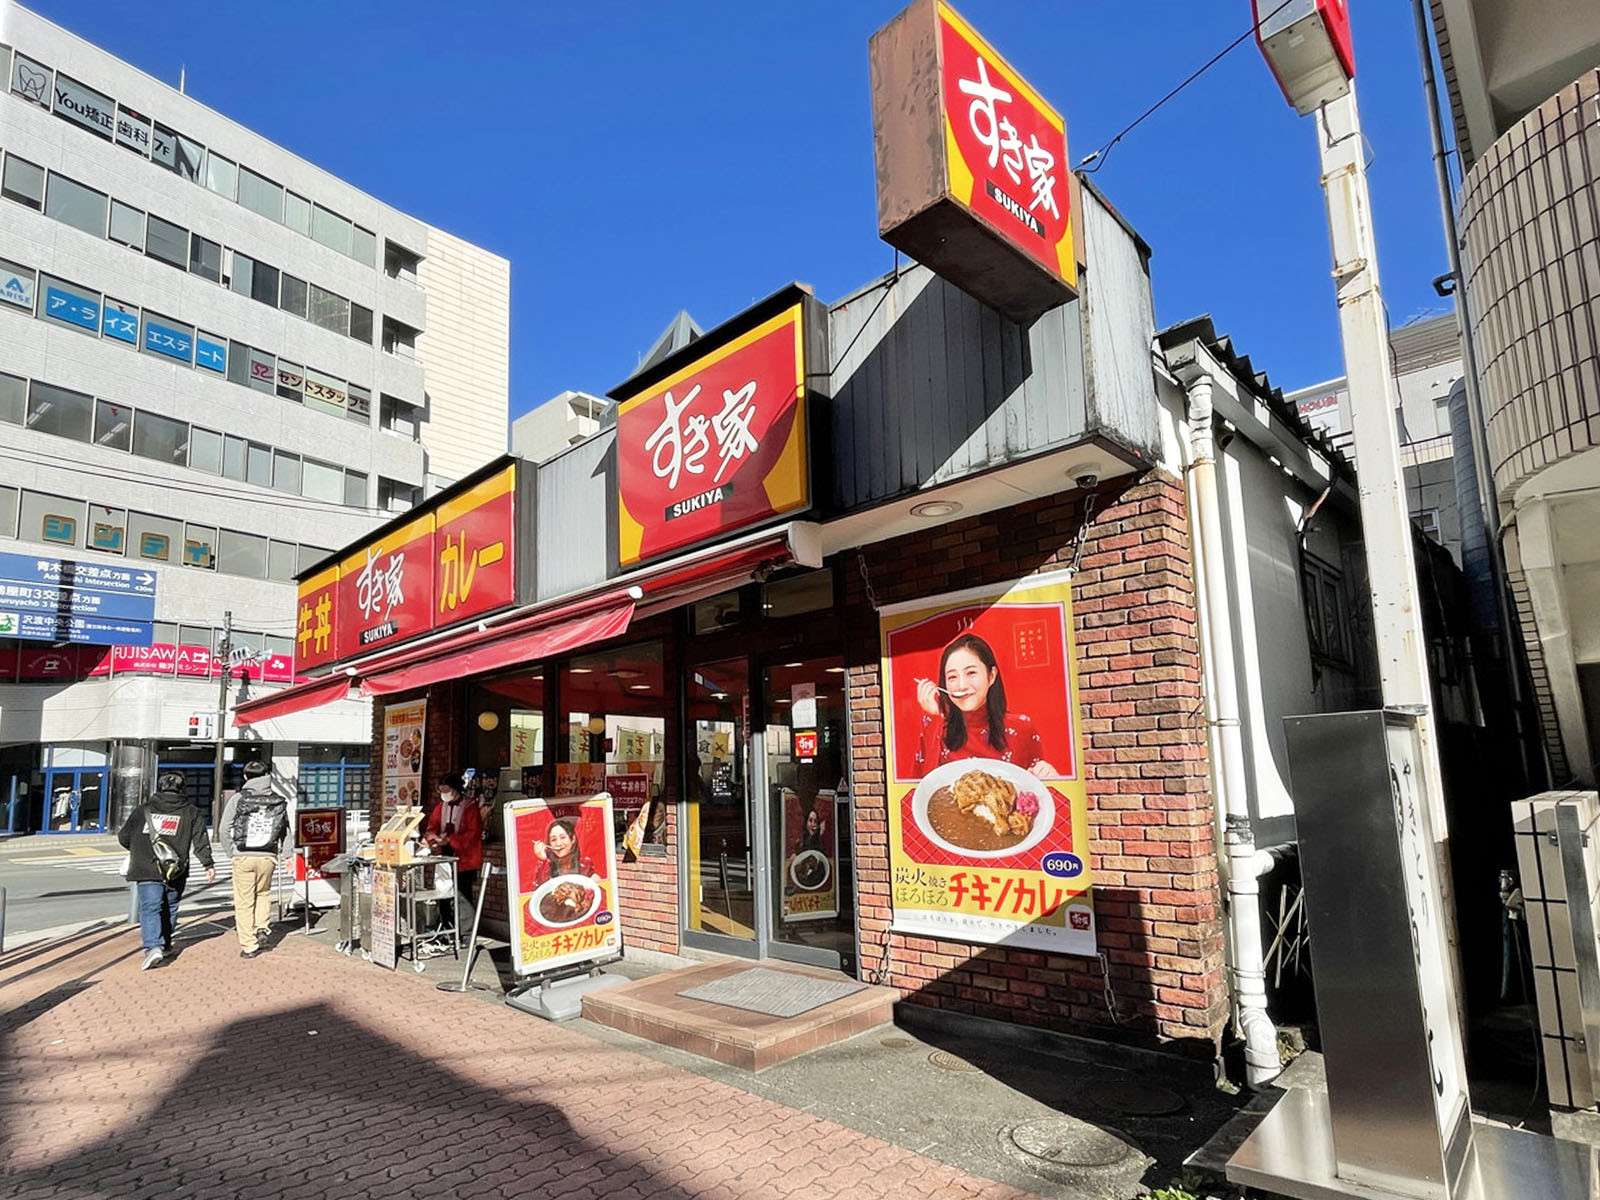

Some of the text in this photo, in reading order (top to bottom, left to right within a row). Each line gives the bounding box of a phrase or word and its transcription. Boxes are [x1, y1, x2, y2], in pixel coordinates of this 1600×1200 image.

[55, 88, 149, 146] You矯正歯科
[958, 56, 1060, 220] すき家
[993, 187, 1040, 233] SUKIYA
[645, 380, 759, 490] すき家
[672, 487, 724, 518] SUKIYA
[356, 547, 405, 621] すき家
[440, 529, 504, 613] カレー
[298, 592, 332, 658] 牛丼
[364, 622, 394, 644] SUKIYA
[114, 645, 190, 662] FUJISAWA
[1046, 859, 1079, 872] 690円
[895, 866, 1088, 917] 炭火焼き チキンカレー
[895, 887, 949, 907] ほろほろ
[552, 928, 614, 955] チキンカレー
